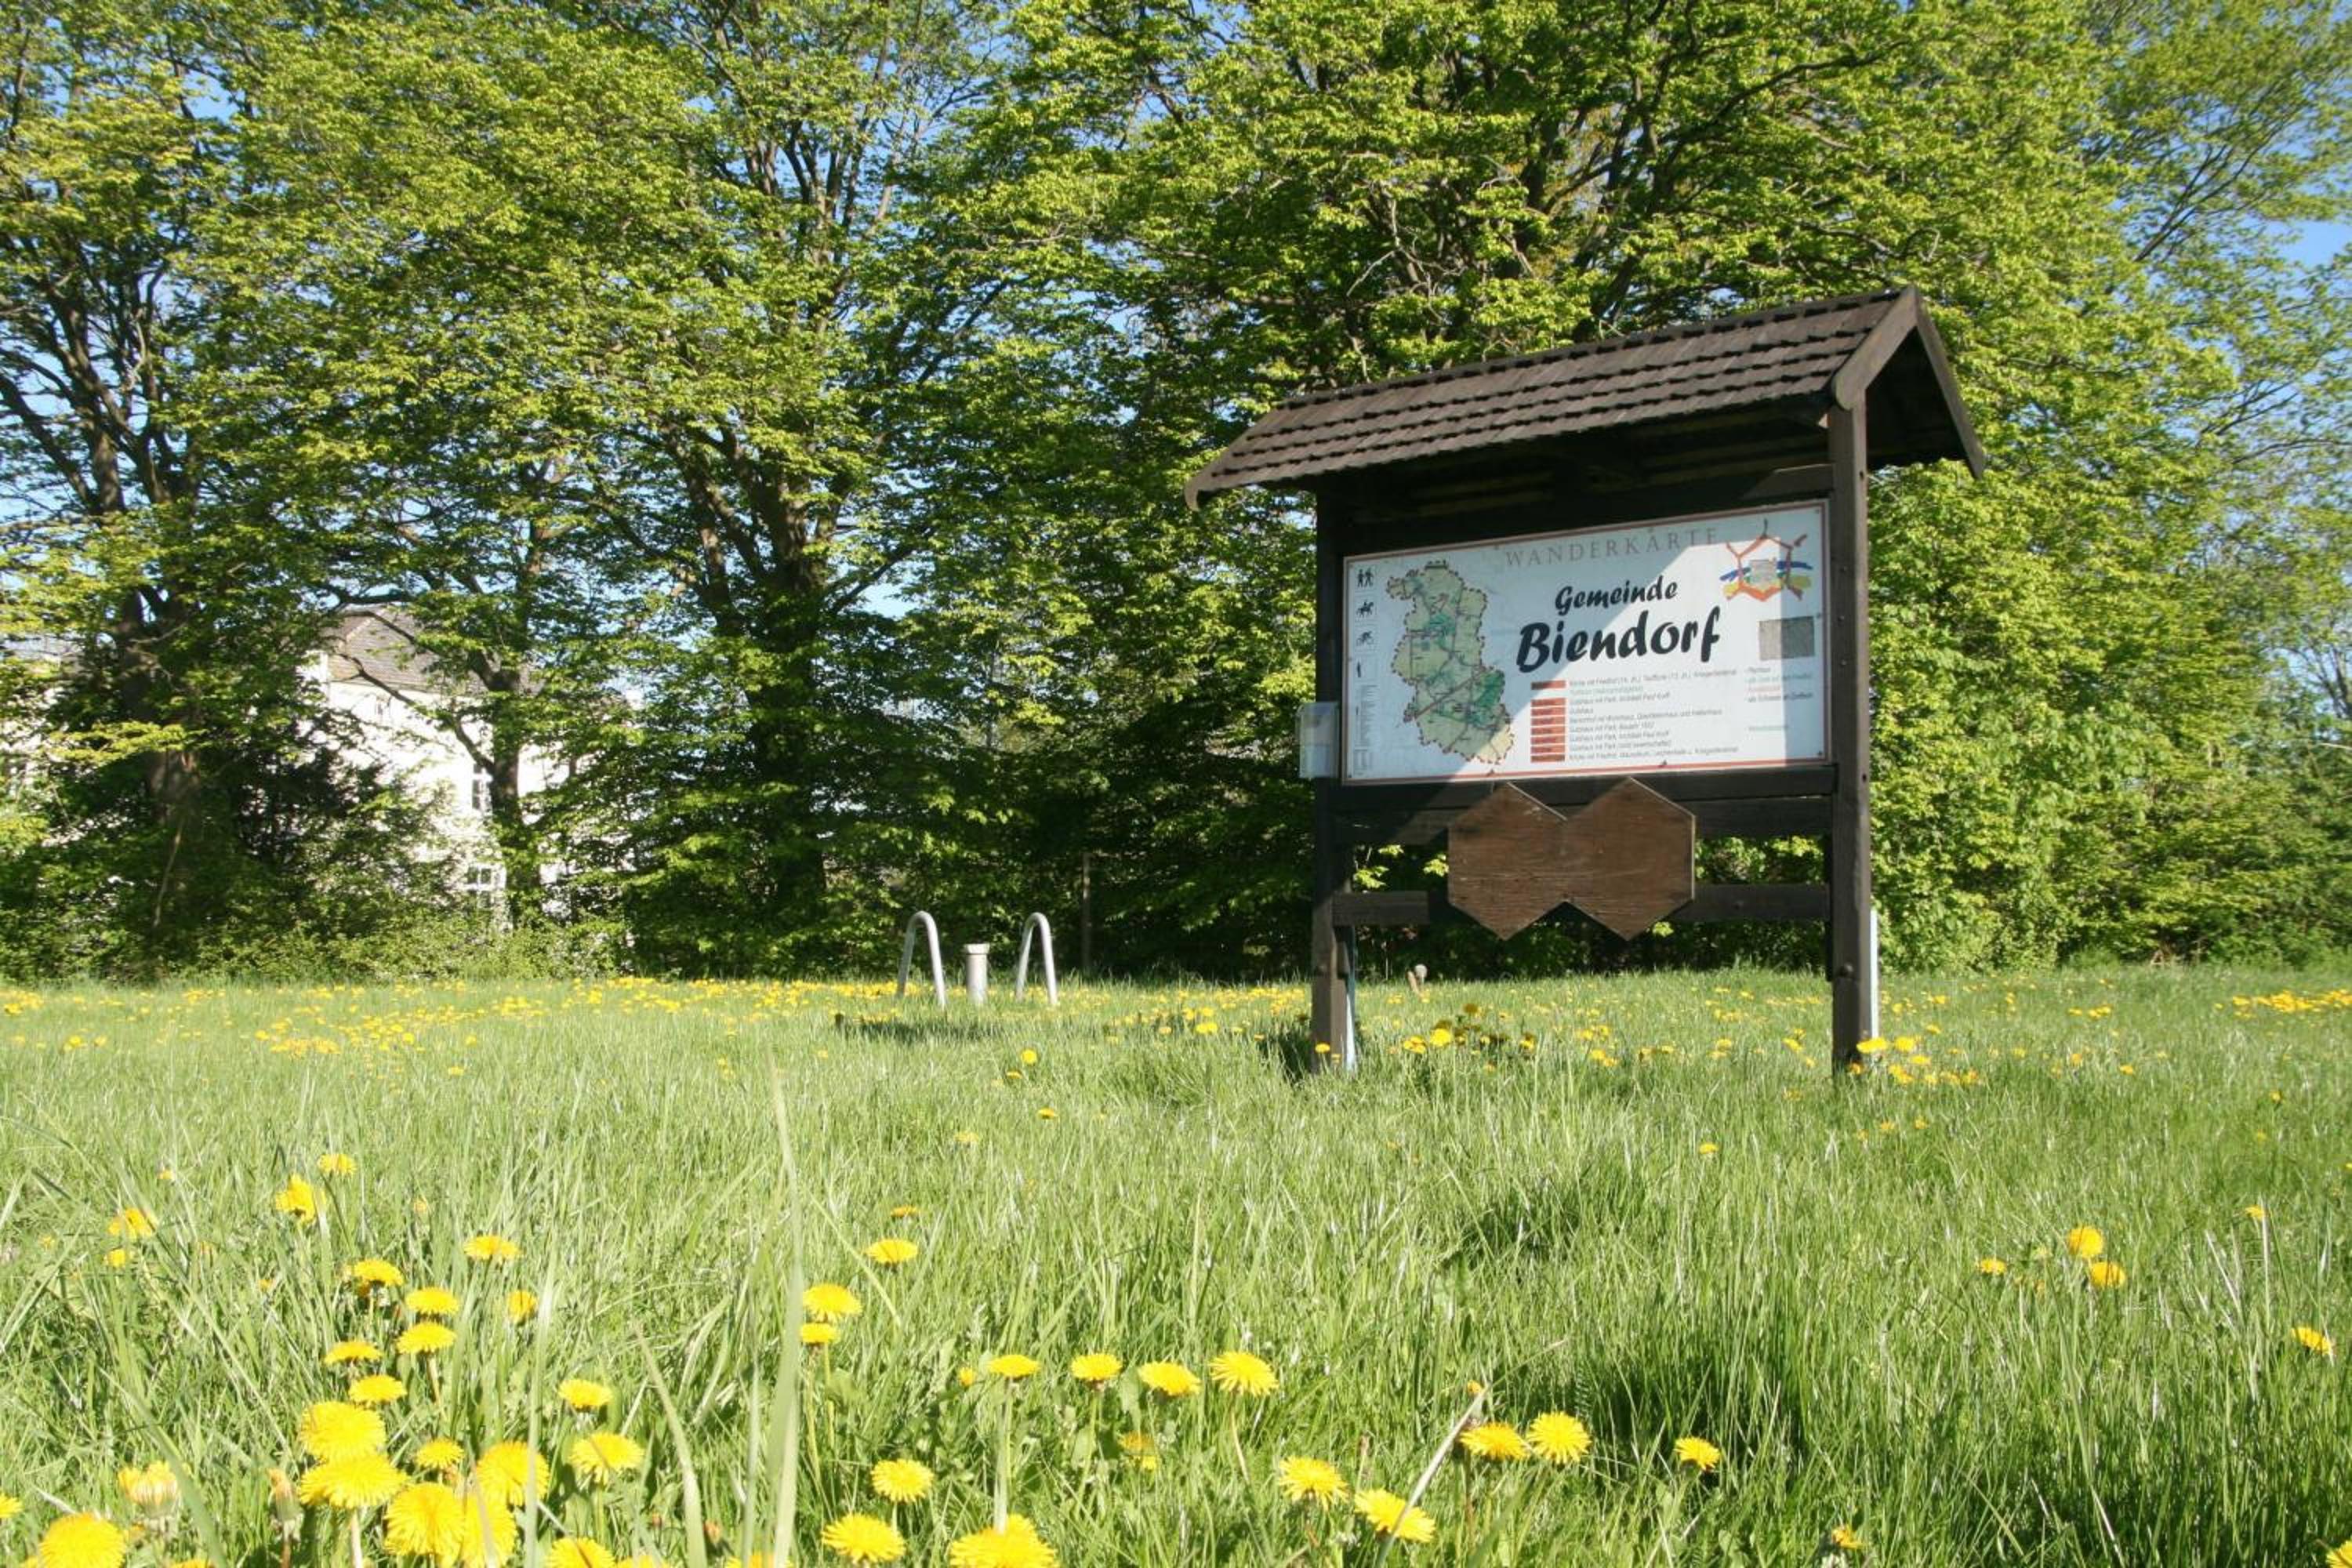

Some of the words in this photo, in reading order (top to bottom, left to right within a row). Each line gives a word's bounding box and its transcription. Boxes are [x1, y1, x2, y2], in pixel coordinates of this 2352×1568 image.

[1506, 528, 1718, 567] WANDERKARTE
[1555, 575, 1678, 616] Gemeinde
[1516, 605, 1721, 673] Biendorf
